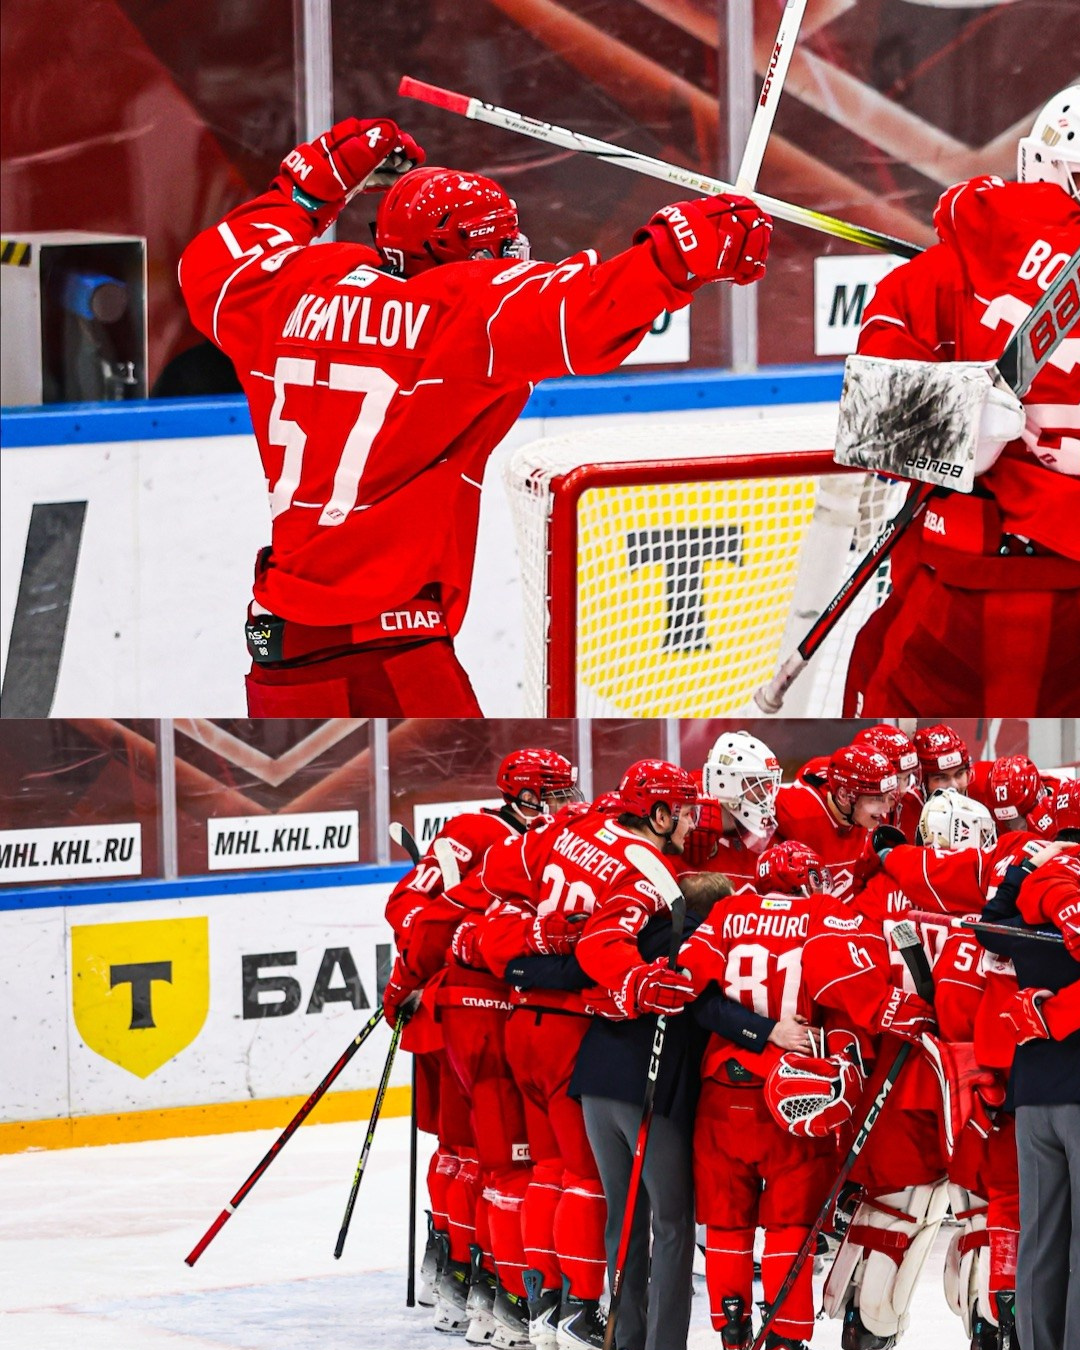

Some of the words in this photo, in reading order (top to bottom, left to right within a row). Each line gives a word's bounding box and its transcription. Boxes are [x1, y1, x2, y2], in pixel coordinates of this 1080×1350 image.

[268, 356, 399, 526] 57
[215, 825, 352, 855] MHL.KHL.RU
[725, 943, 803, 1024] 81
[852, 1076, 893, 1155] CCM
